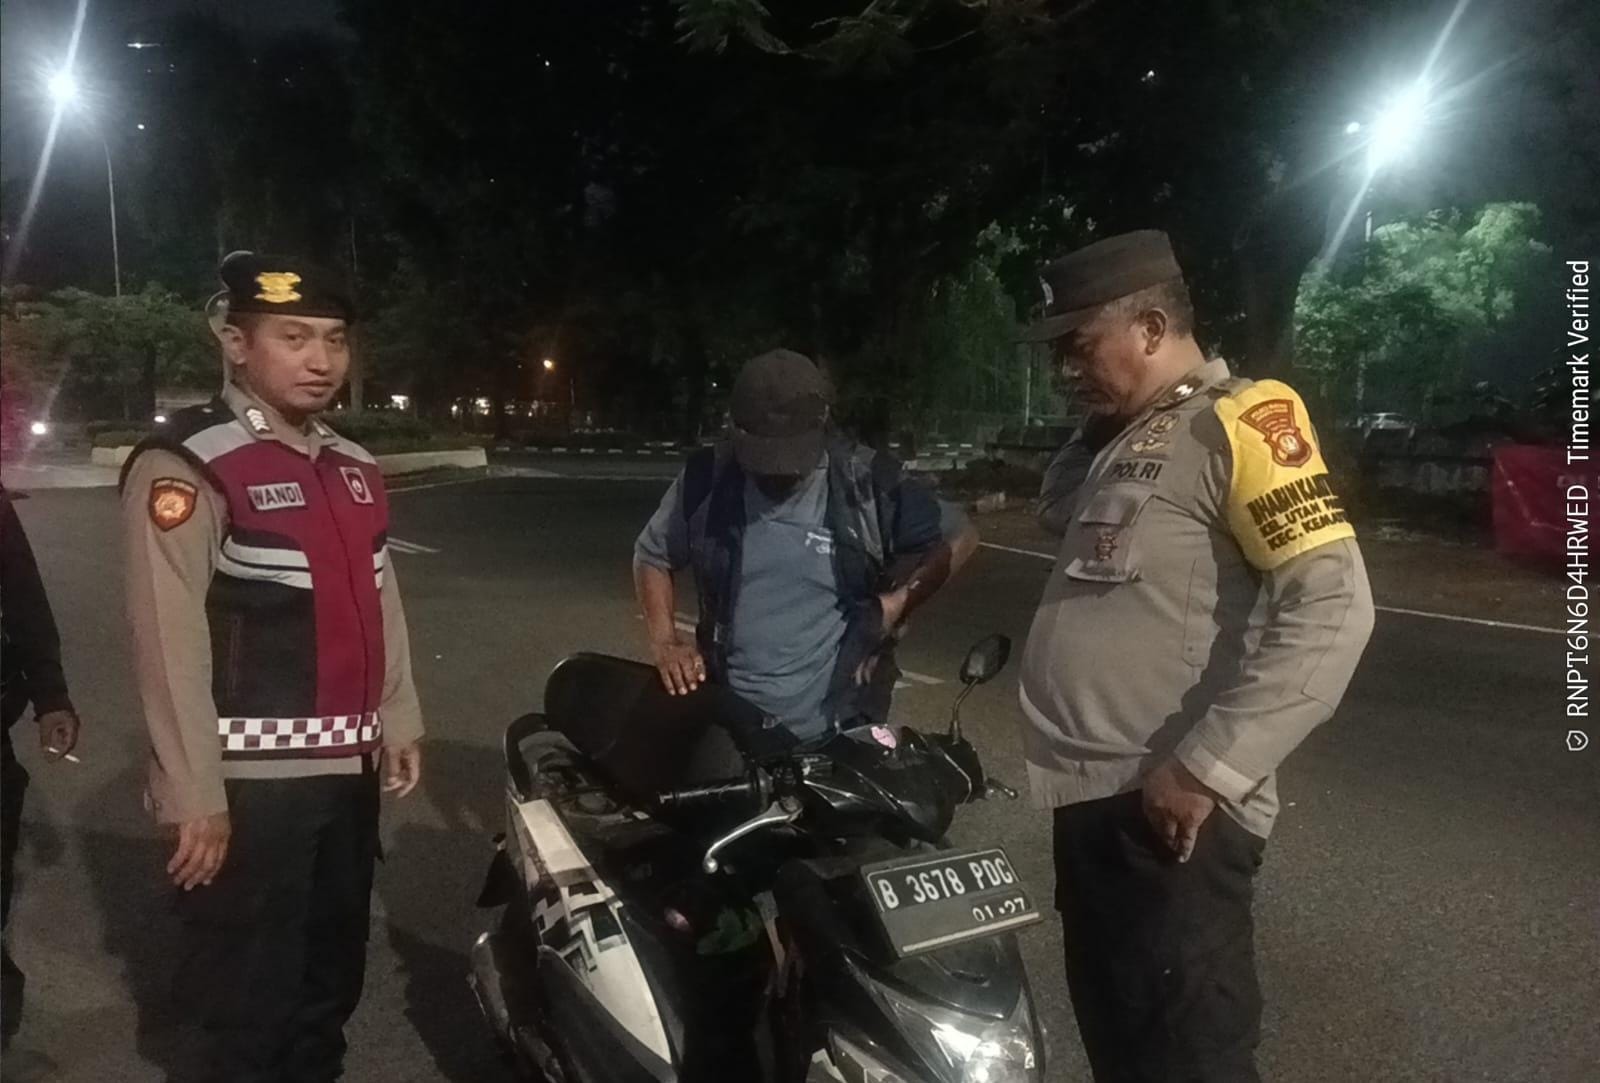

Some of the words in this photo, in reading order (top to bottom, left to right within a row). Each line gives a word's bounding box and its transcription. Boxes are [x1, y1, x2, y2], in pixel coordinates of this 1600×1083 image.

[1111, 462, 1163, 480] POLRI
[253, 485, 302, 506] WANDI
[877, 878, 900, 909] B
[905, 867, 965, 903] 3678
